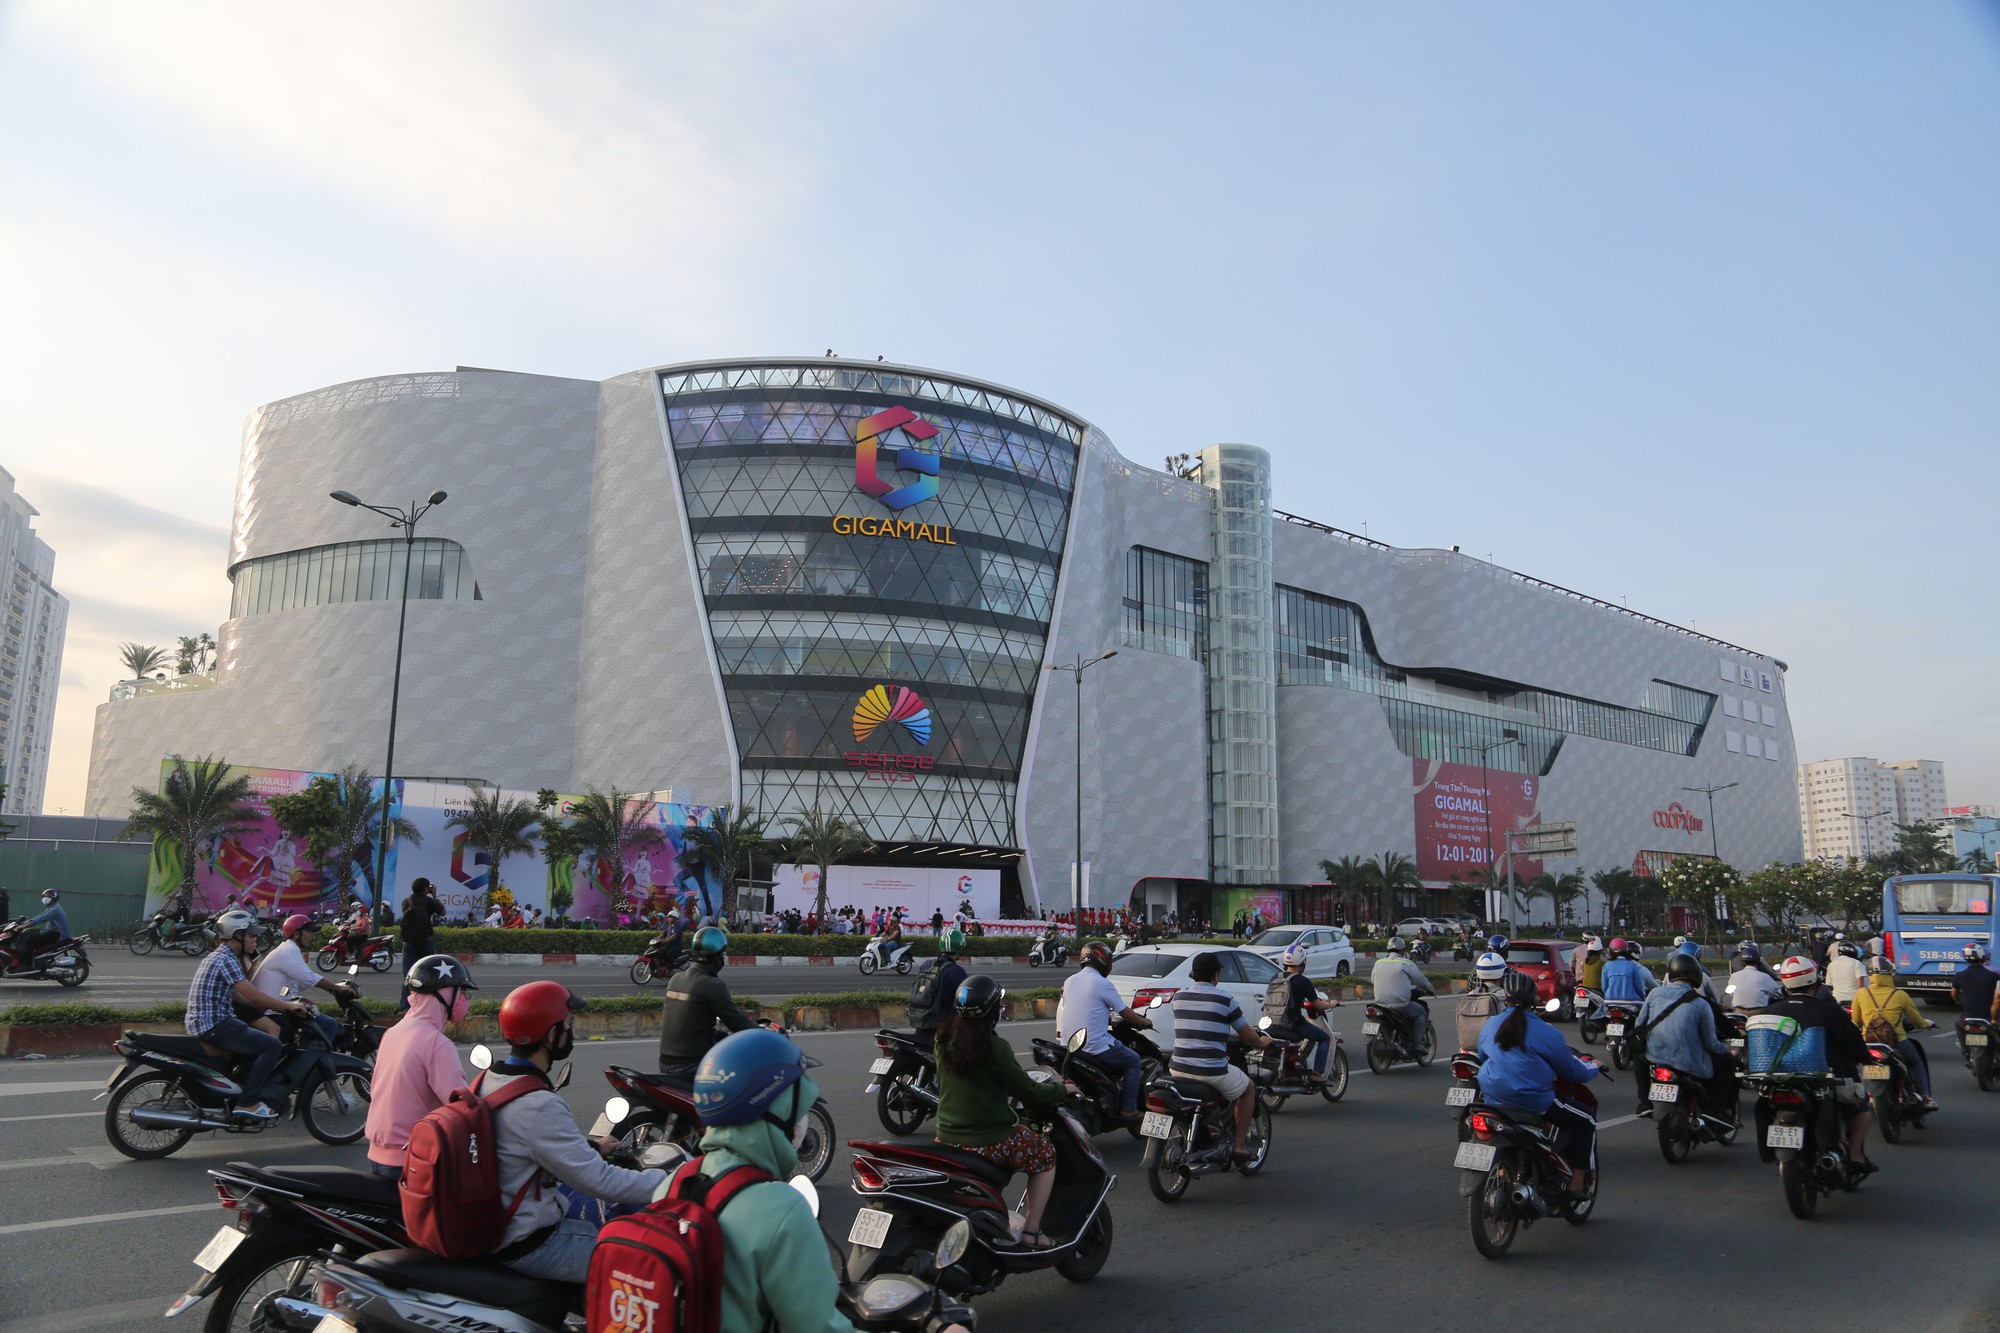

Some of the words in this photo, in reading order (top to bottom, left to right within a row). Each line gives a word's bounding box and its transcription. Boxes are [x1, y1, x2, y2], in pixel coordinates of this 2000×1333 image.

[832, 515, 957, 545] GIGAMALL
[845, 752, 934, 770] sense
[867, 767, 914, 782] city
[444, 808, 469, 819] 0947
[1951, 806, 1970, 815] HOME
[1920, 951, 1963, 960] 51B-166.
[1452, 1088, 1471, 1098] 93-C1
[1655, 1084, 1674, 1093] 77-E1
[1774, 1127, 1798, 1137] 59-E1
[1769, 1136, 1800, 1146] 281.14
[1463, 1144, 1489, 1158] 59-S1
[326, 1207, 389, 1225] BLADE
[860, 1212, 888, 1229] 55-X7
[855, 1226, 882, 1245] 6194
[610, 1289, 660, 1333] GET
